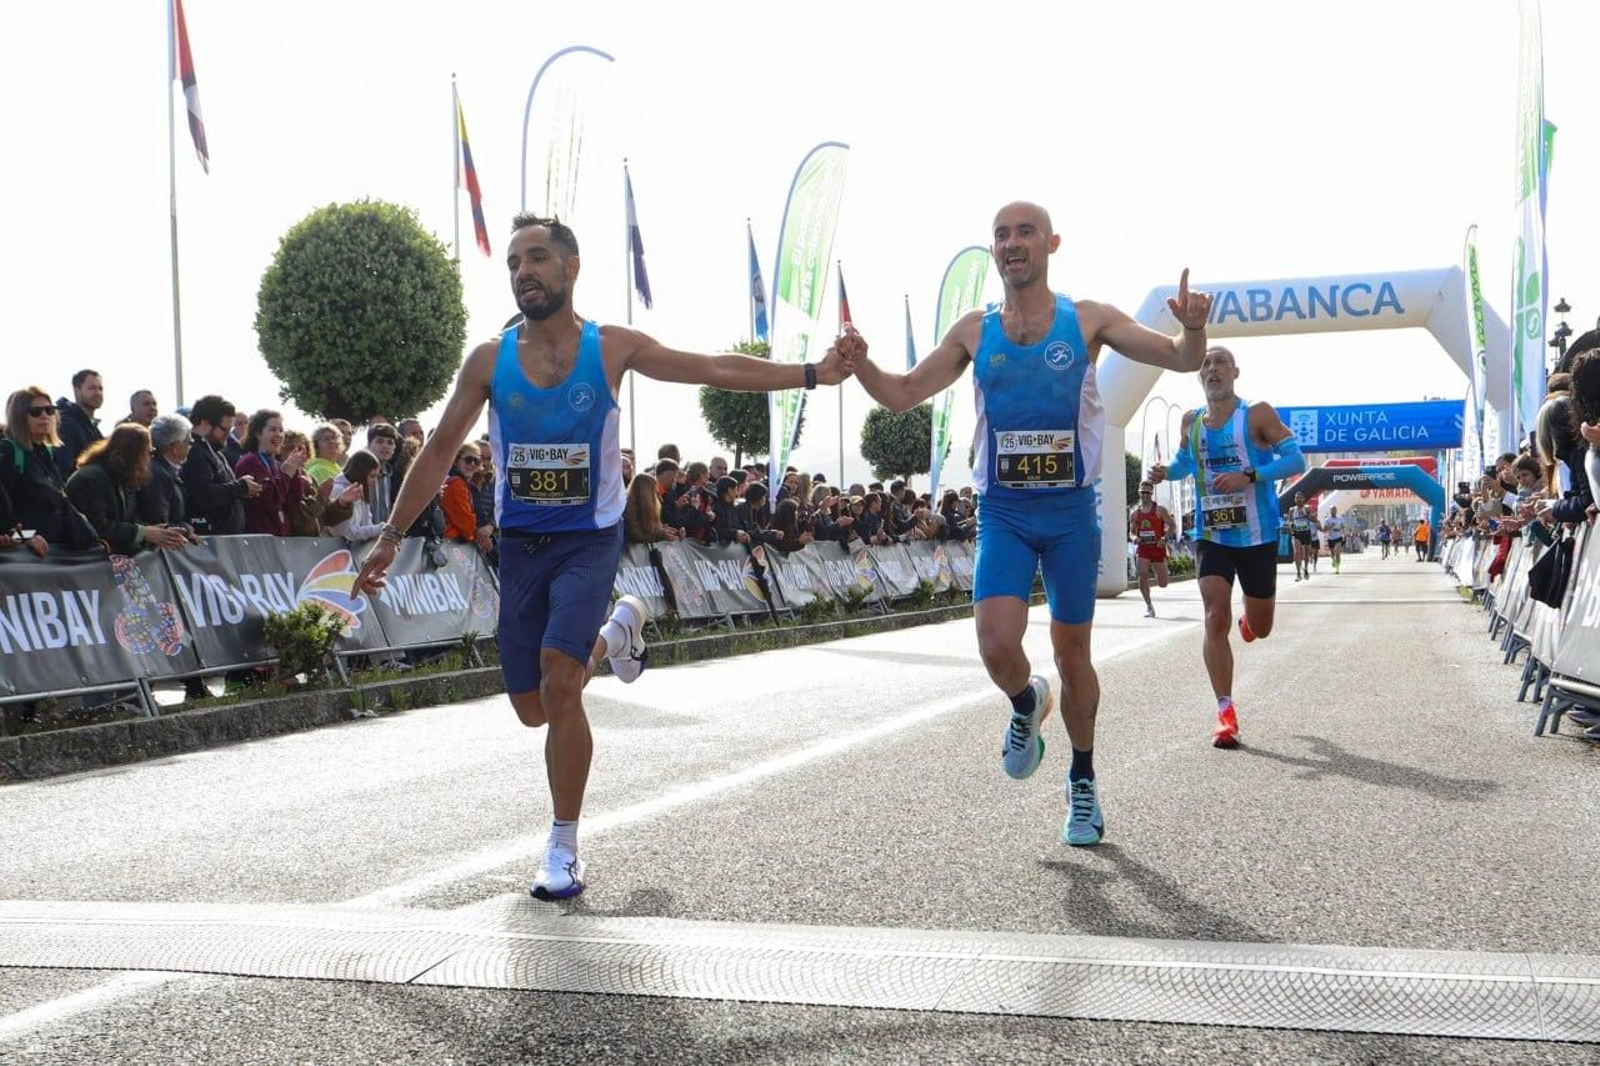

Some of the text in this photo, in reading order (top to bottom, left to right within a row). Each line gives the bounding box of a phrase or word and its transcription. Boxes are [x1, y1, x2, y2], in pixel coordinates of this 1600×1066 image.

[1217, 281, 1405, 324] ABANCA
[1325, 411, 1388, 426] XUNTA
[1325, 425, 1429, 442] DE GALICIA
[1017, 455, 1058, 475] 415
[529, 470, 569, 491] 381
[1333, 473, 1395, 482] POWERADE
[1212, 509, 1236, 522] 361
[0, 589, 106, 654] NIBAY
